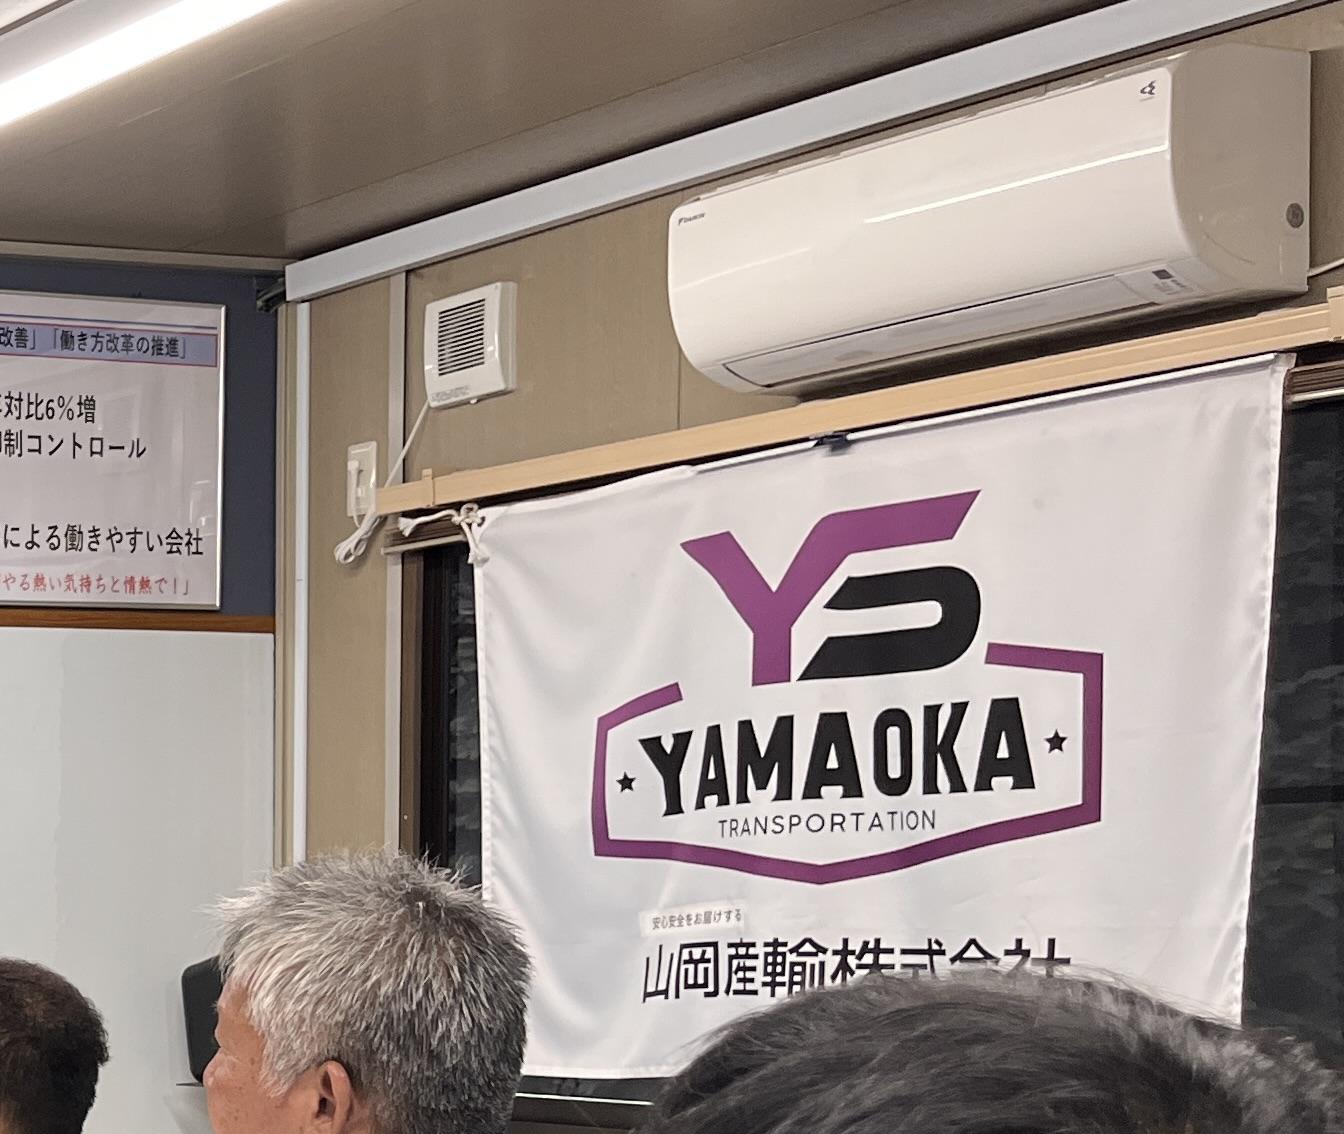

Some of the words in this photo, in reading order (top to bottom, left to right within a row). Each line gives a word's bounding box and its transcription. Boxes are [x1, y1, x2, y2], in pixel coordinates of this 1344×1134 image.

[638, 696, 1036, 818] YAMAOKA
[718, 808, 937, 840] TRANSPORTATION
[651, 907, 743, 931] 安心安全をお届けする
